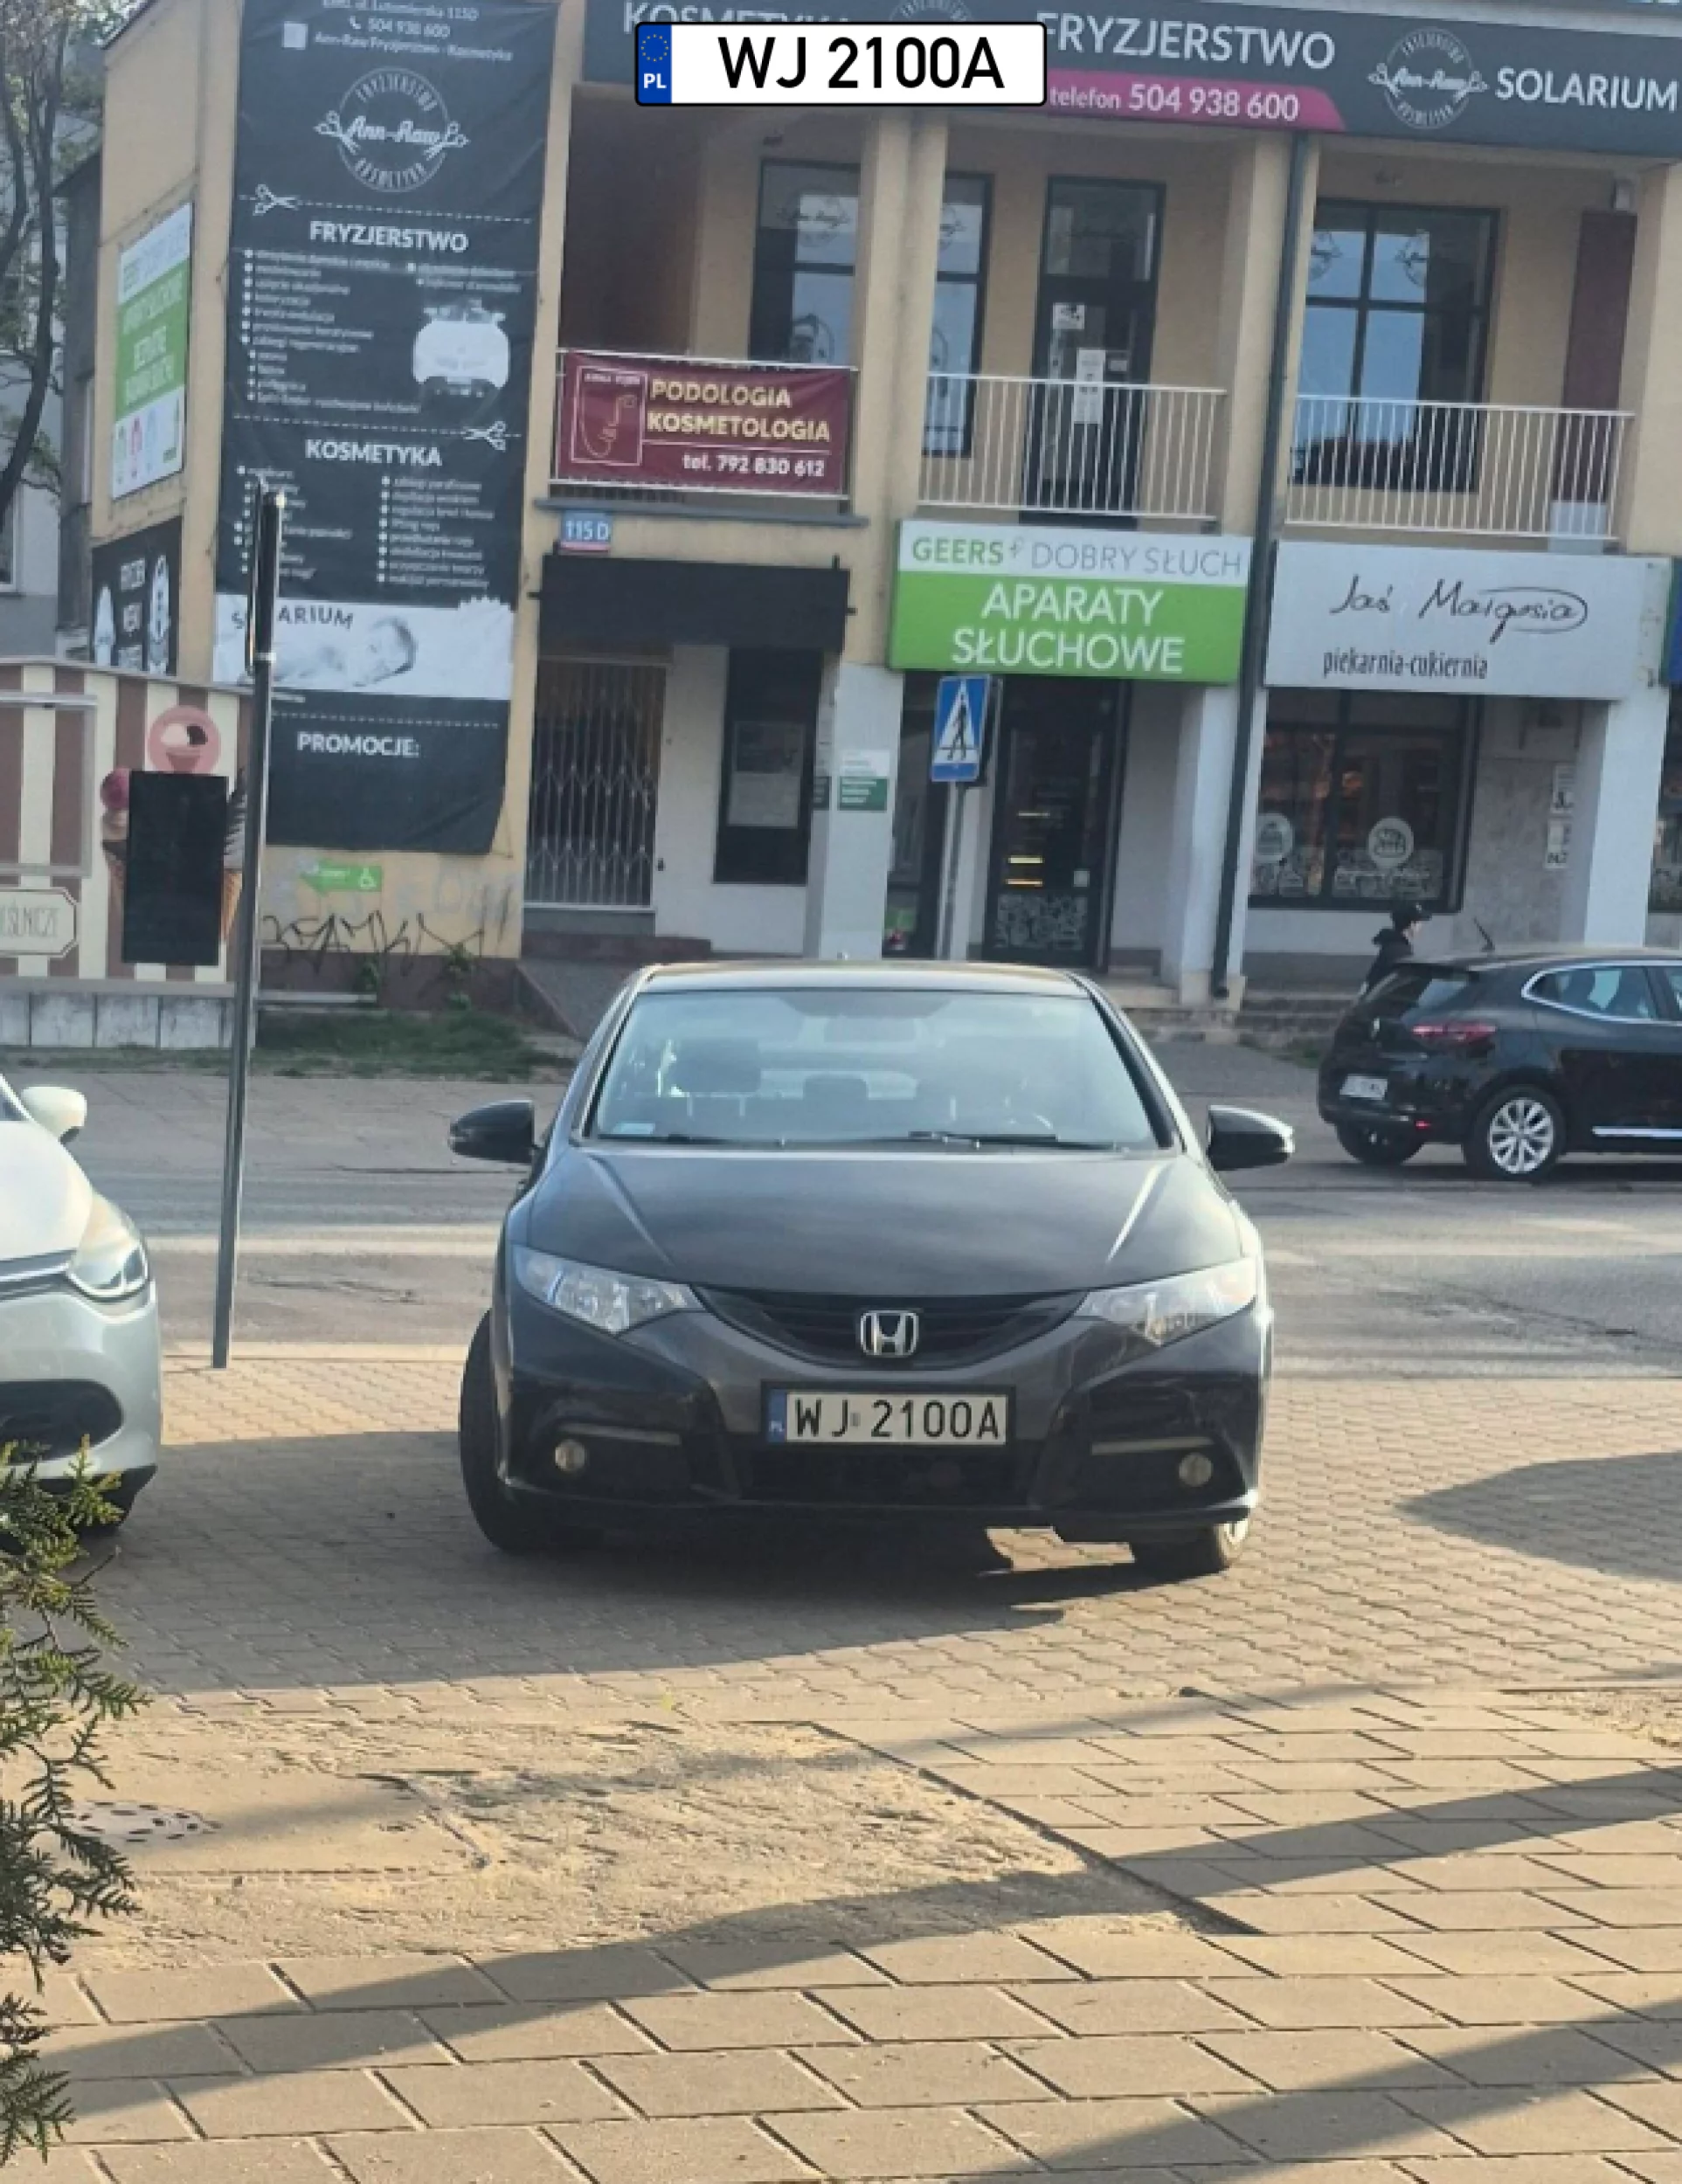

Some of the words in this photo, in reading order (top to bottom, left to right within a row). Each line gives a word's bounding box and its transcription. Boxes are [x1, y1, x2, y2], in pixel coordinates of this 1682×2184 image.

[1036, 12, 1335, 69] FRYZJERSTWO
[1049, 86, 1120, 110] telefon
[1128, 83, 1182, 113] 504
[1189, 87, 1240, 117] 938
[1247, 91, 1300, 121] 600
[1494, 66, 1679, 113] SOLARIUM
[309, 220, 469, 253] FRYZJERSTWO
[649, 378, 792, 408] PODOLOGIA
[647, 411, 831, 442] KOSMETOLOGIA
[304, 439, 443, 467] KOSMETYKA
[682, 453, 712, 472] tel.
[716, 455, 750, 473] 792
[794, 460, 825, 477] 612
[912, 536, 1004, 566] GEERS
[1031, 542, 1135, 572] DOBRY
[1144, 547, 1242, 577] SŁUCH
[980, 583, 1165, 626] APARATY
[1329, 574, 1393, 614] Jaś
[230, 604, 355, 632] SARIUM
[951, 626, 1186, 674] SŁUCHOWE
[1323, 647, 1488, 680] piekarnia-cukiernia
[296, 731, 419, 758] PROMOCJE:
[794, 1398, 849, 1439] WJ
[871, 1398, 1000, 1441] 2100A
